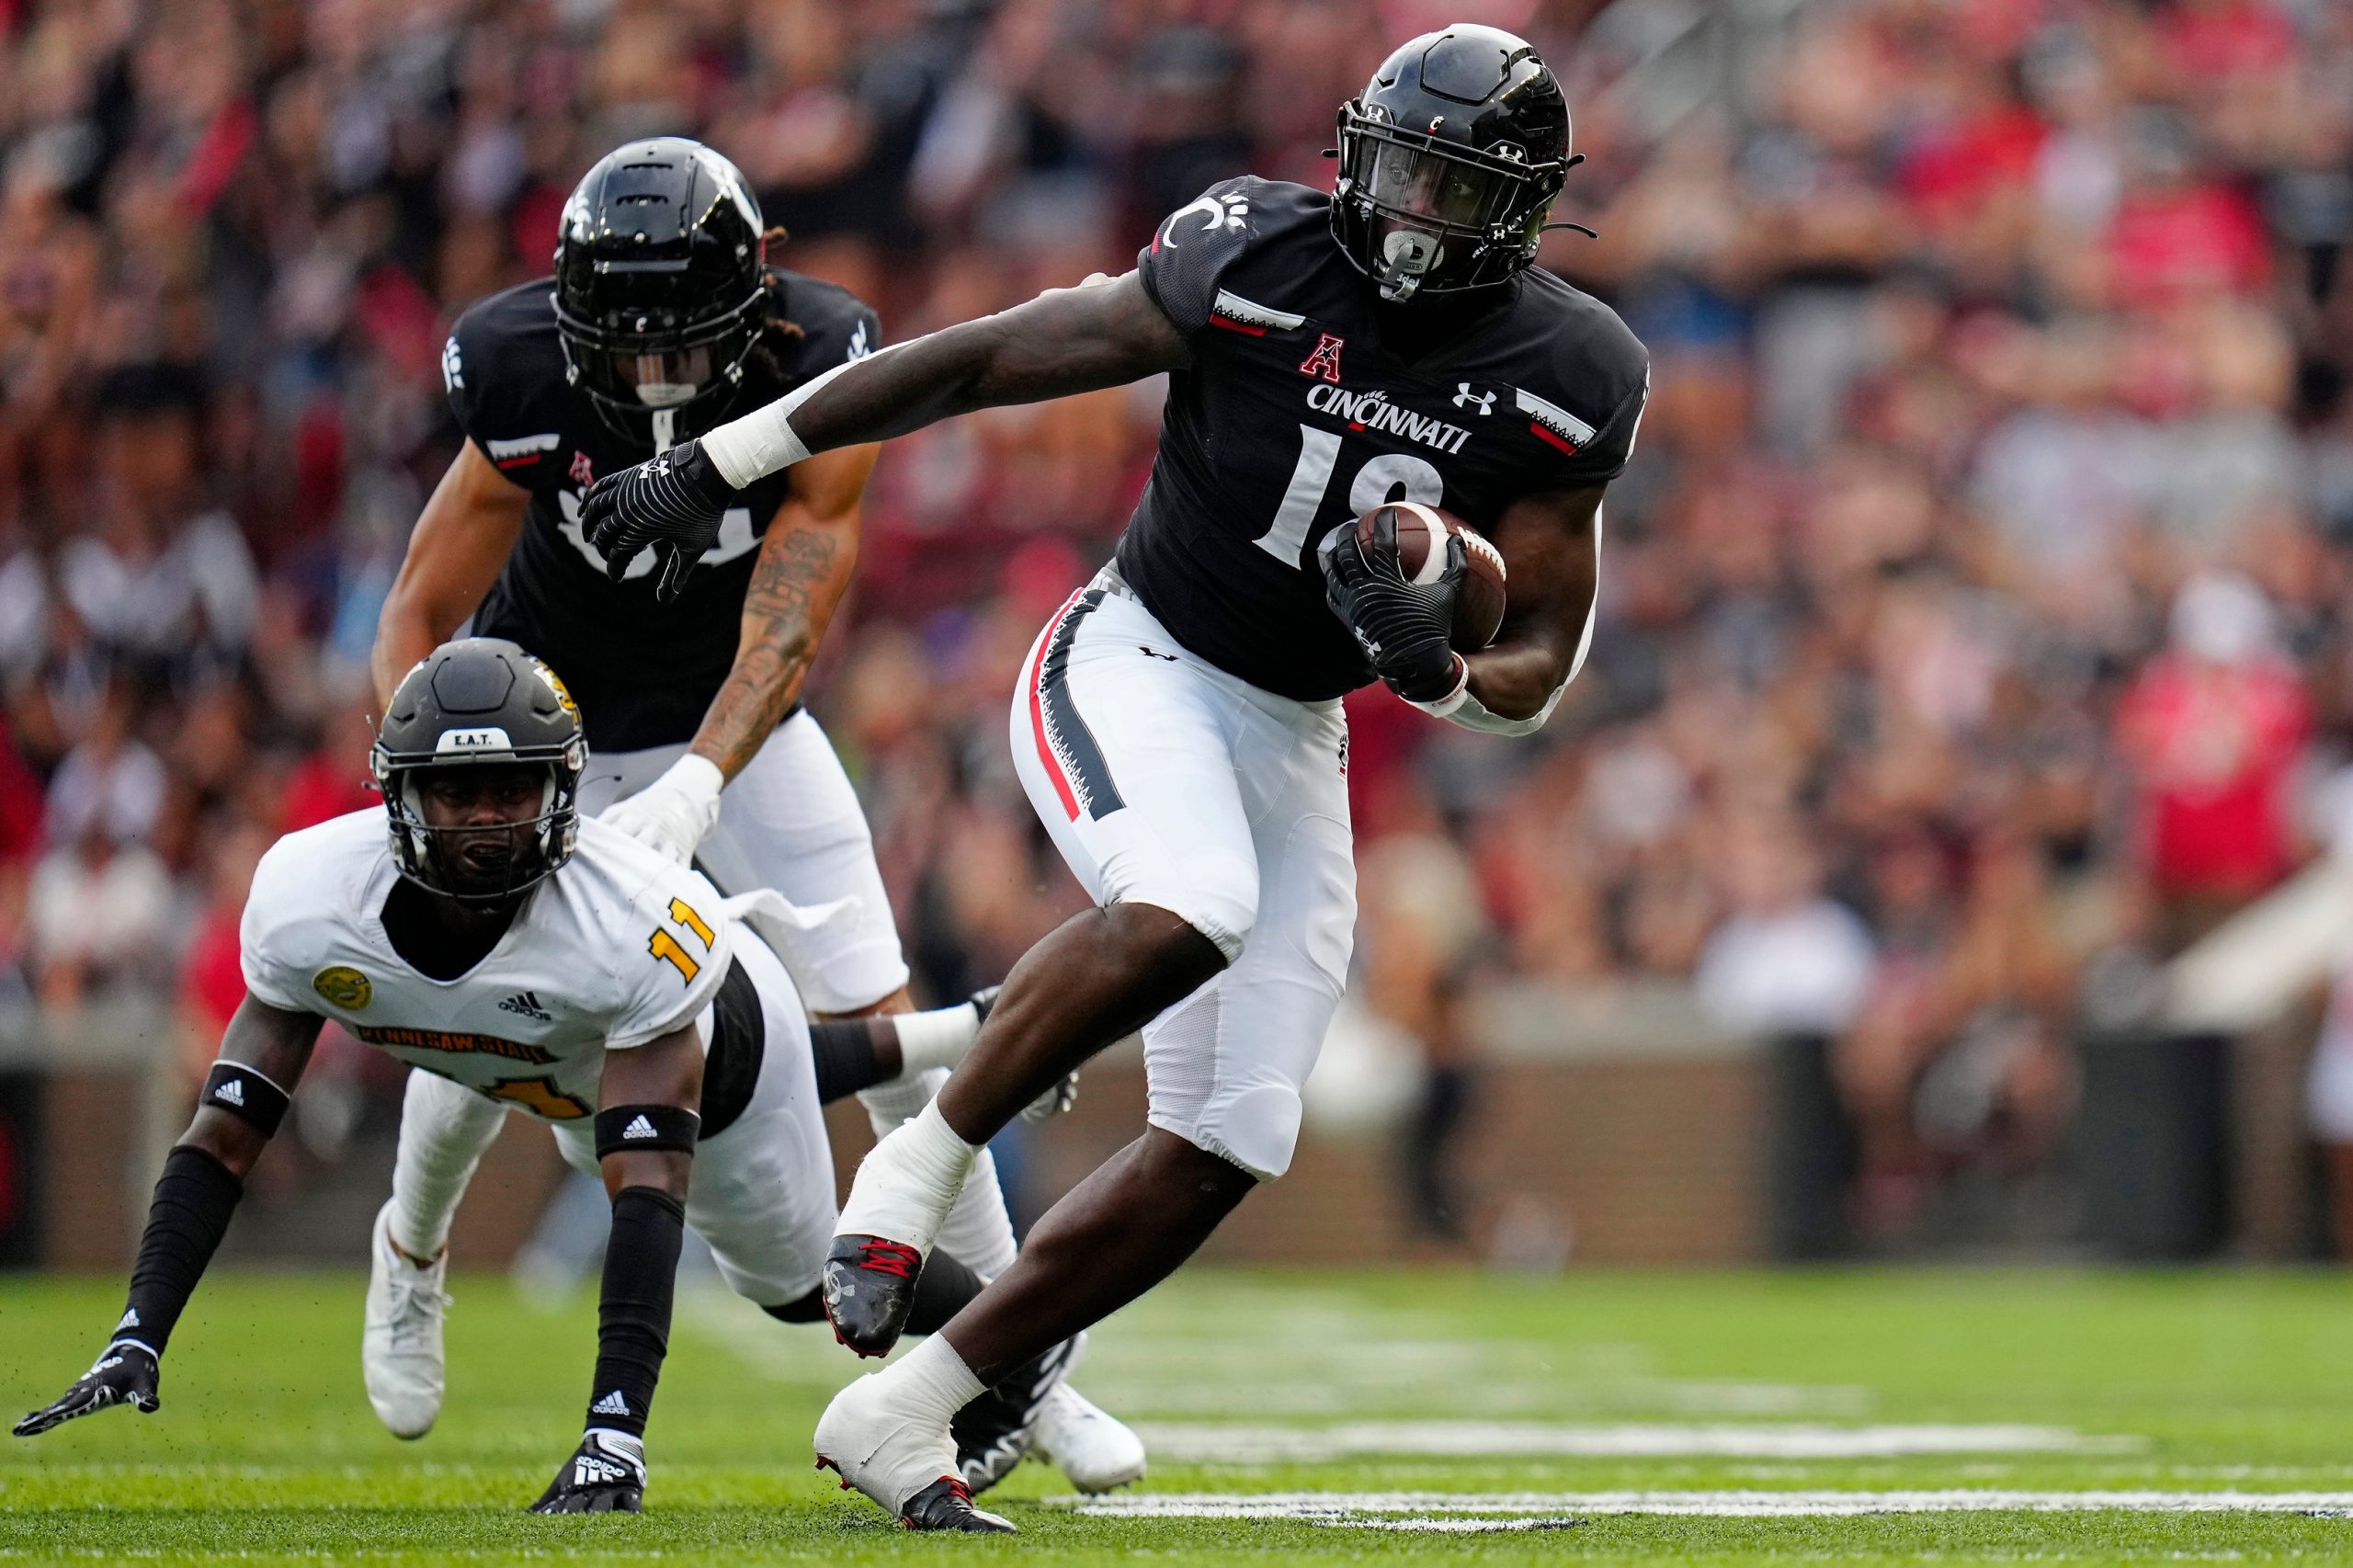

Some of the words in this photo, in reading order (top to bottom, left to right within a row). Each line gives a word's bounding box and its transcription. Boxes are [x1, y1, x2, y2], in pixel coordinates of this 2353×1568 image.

[1299, 332, 1346, 383] A
[1306, 383, 1472, 455] CINCINNATI
[454, 733, 493, 745] E.A.T.
[647, 896, 715, 989] 11
[498, 1002, 551, 1021] adidas
[622, 1129, 658, 1140] adidas
[592, 1404, 631, 1416] adidas
[575, 1454, 626, 1478] adidas
